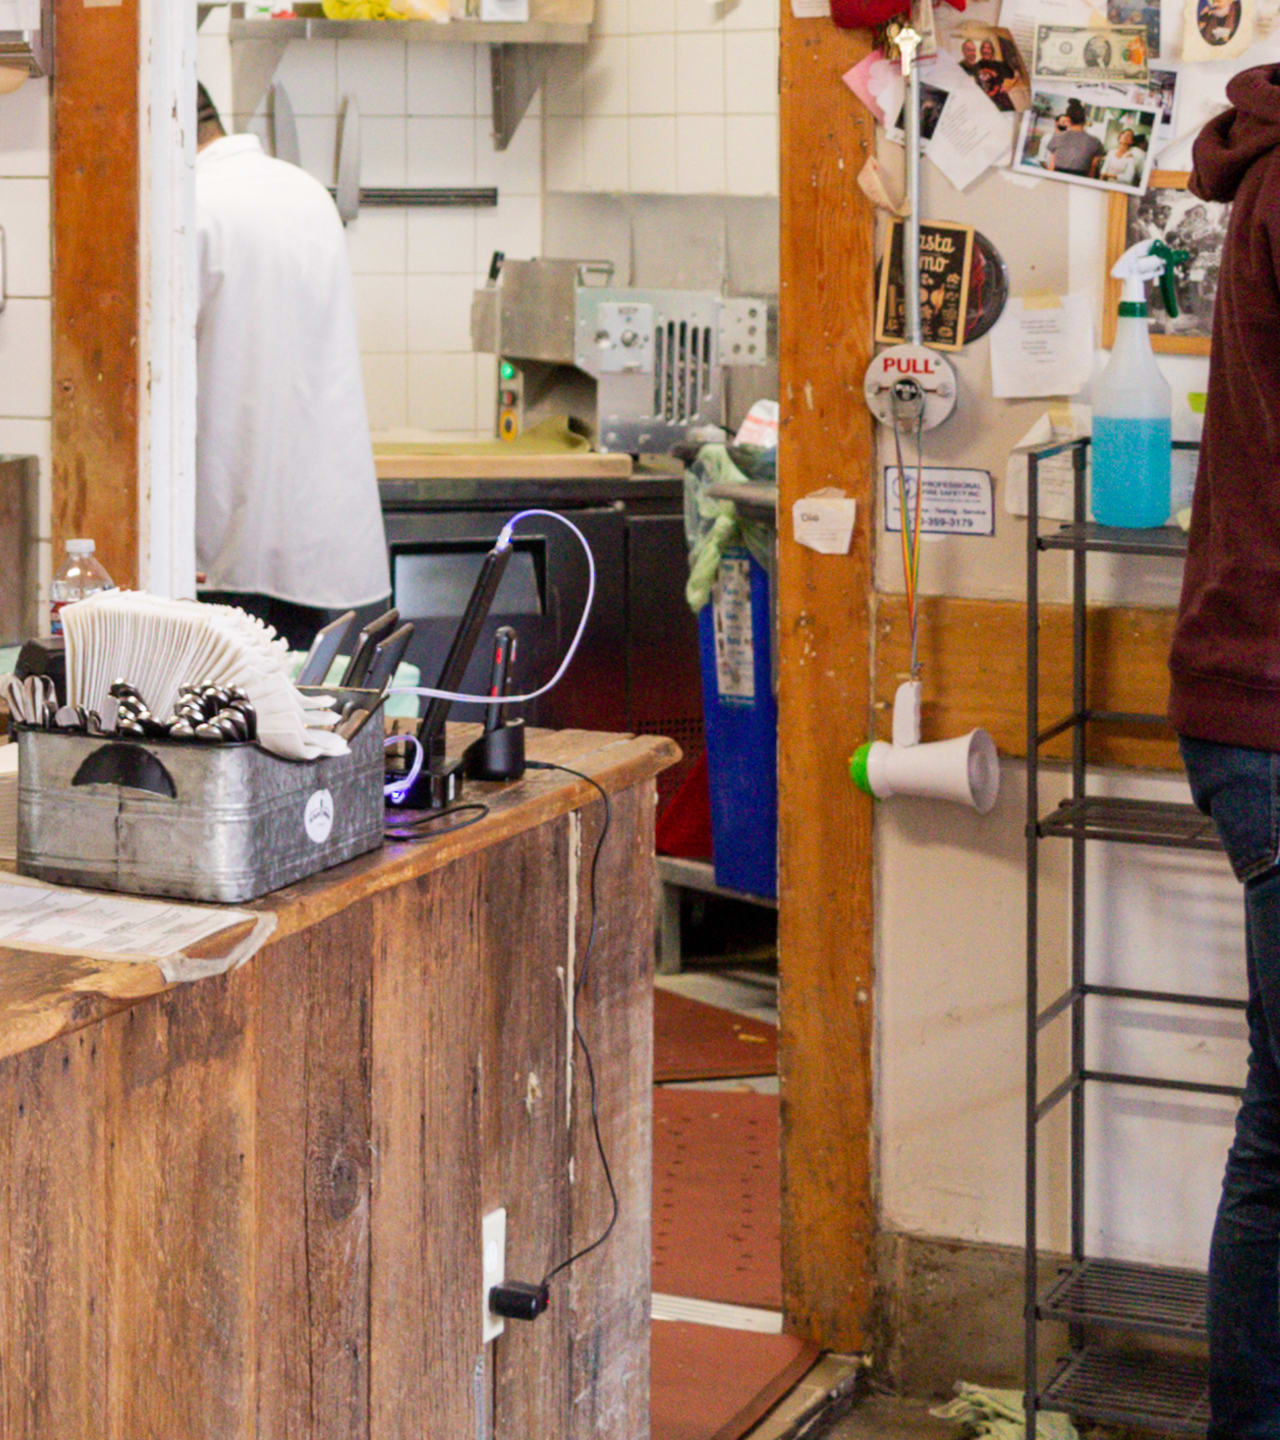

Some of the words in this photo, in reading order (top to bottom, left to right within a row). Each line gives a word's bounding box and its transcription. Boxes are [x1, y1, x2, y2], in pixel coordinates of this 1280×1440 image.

[883, 357, 935, 374] PULL
[922, 481, 981, 490] PROFESSIONAL
[939, 490, 966, 498] SAFETY
